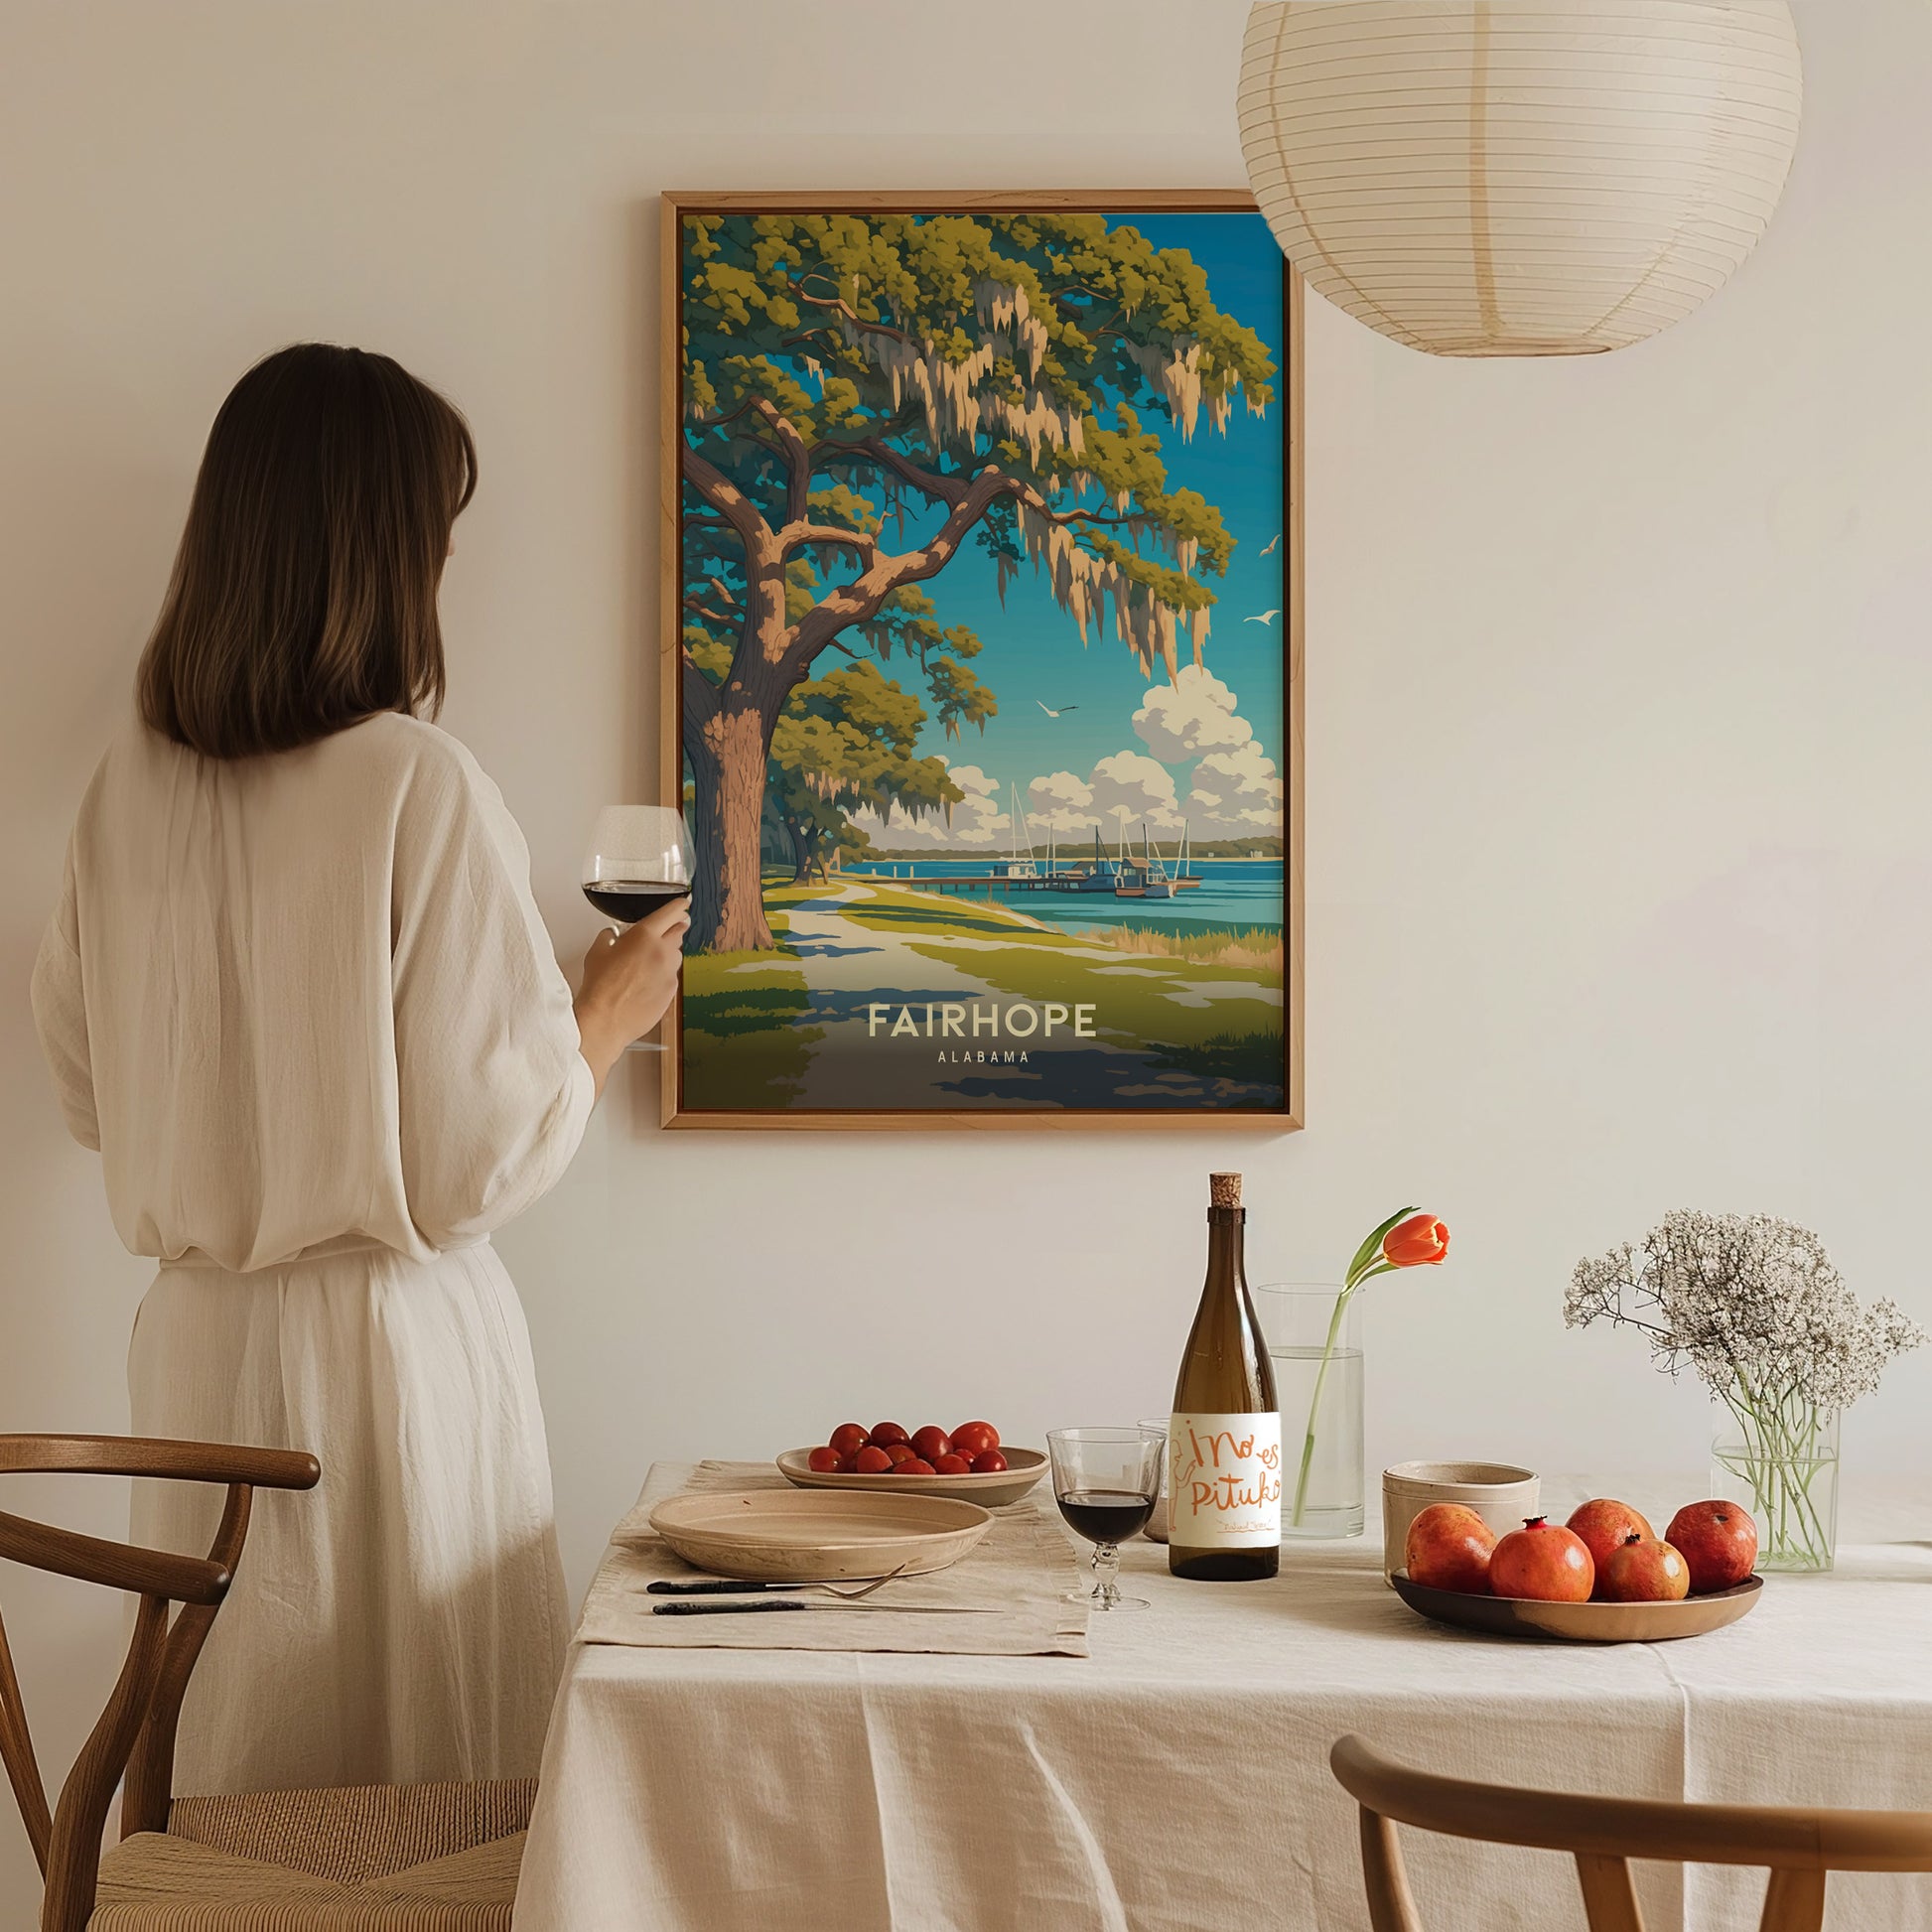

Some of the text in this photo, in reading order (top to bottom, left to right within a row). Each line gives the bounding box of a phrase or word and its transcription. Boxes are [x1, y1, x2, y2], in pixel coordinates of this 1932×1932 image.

[869, 1004, 1097, 1037] FAIRHOPE
[937, 1050, 1029, 1063] ALABAMA
[1256, 1444, 1279, 1469] es
